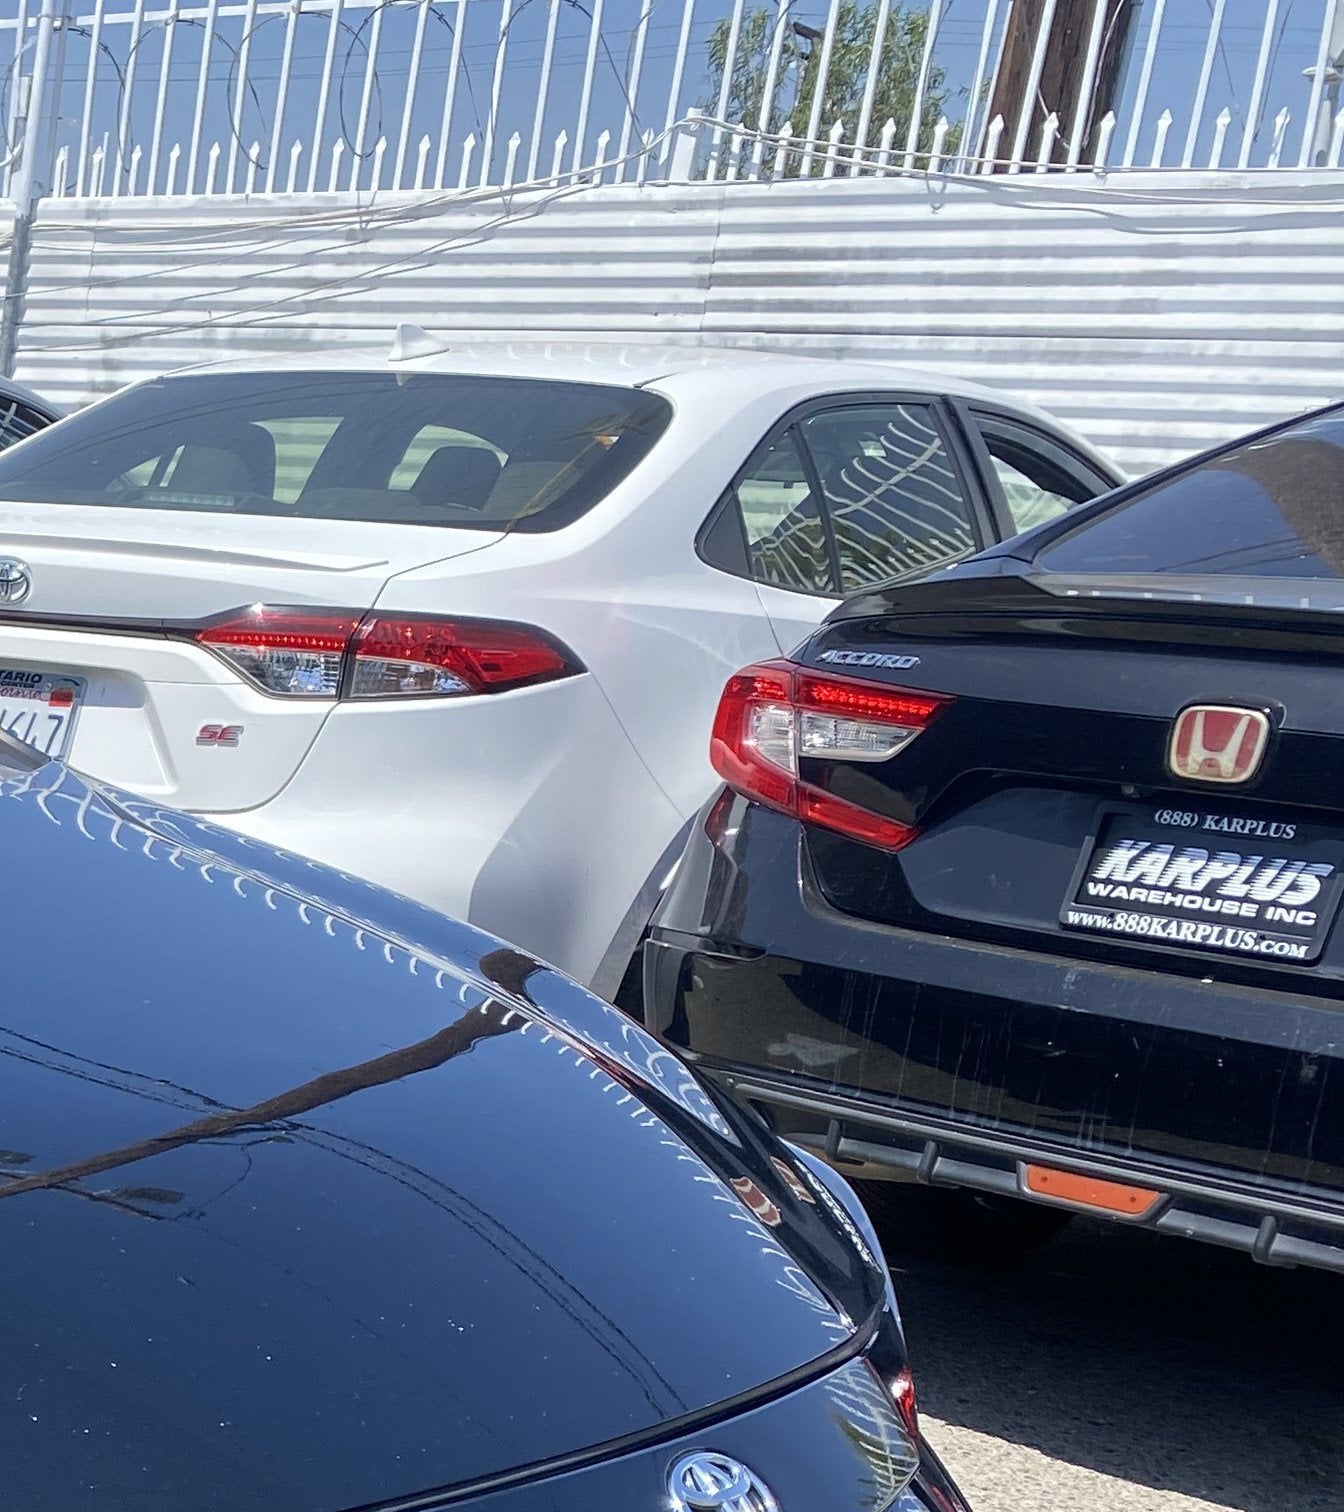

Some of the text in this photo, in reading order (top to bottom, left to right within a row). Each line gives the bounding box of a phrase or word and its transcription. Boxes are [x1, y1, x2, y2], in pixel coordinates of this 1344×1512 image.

[815, 649, 922, 670] ACCORD
[0, 680, 35, 689] CENTER
[196, 724, 244, 747] SE
[1154, 809, 1297, 839] (888) KARPLUS
[1091, 839, 1335, 906] KARPLUS
[1087, 881, 1317, 926] WAREHOUSE INC
